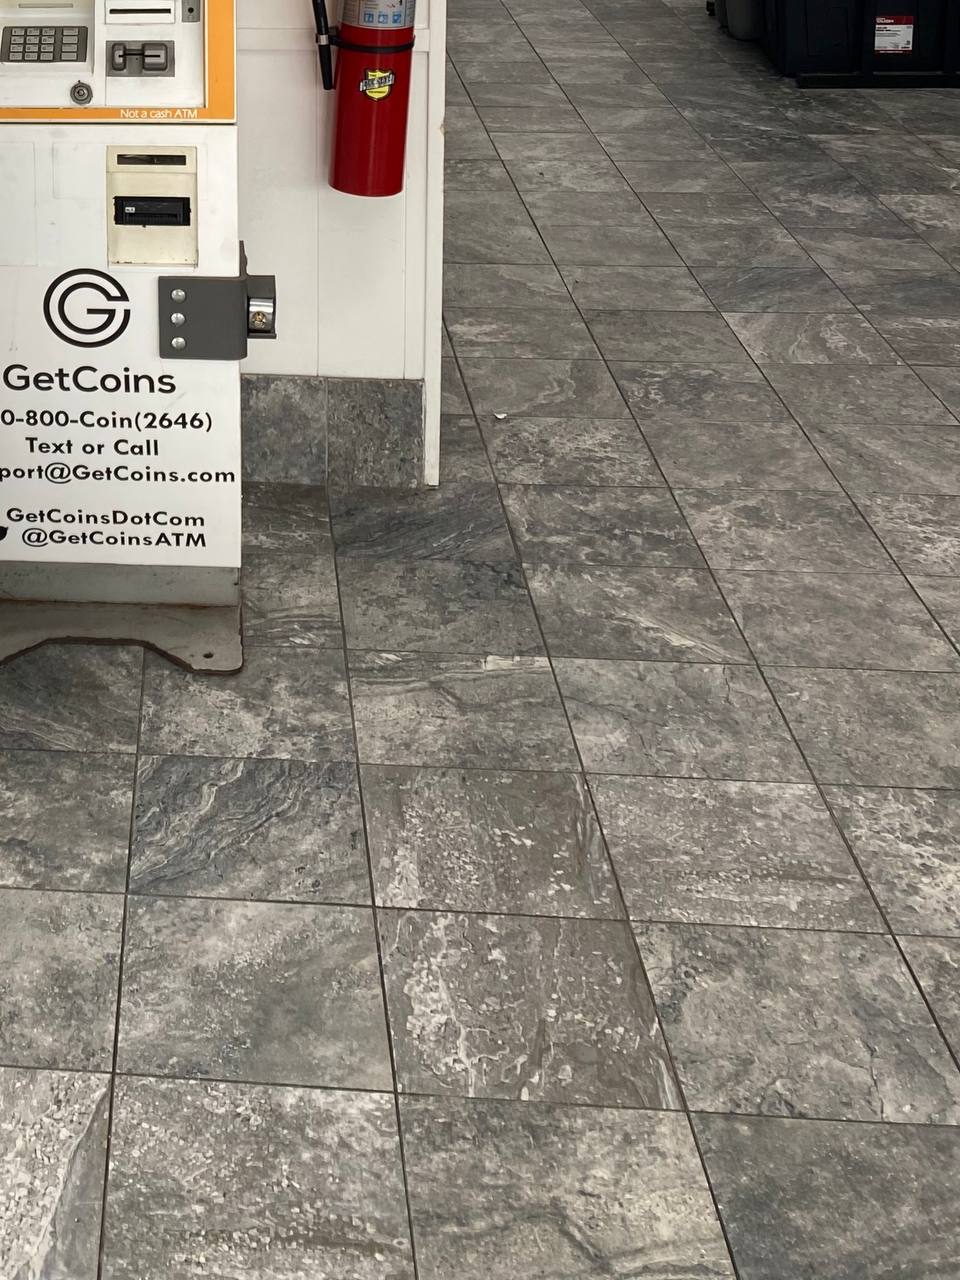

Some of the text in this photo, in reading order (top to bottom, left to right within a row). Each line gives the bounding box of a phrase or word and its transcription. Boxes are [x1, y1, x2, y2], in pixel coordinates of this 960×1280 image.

[120, 109, 138, 118] Not
[150, 109, 172, 118] cash
[174, 109, 198, 119] ATM
[2, 364, 177, 394] GetCoins
[25, 437, 159, 456] Text or Call
[6, 507, 205, 527] GetCoinsDotCom
[21, 528, 206, 547] @GetCoinsATM
